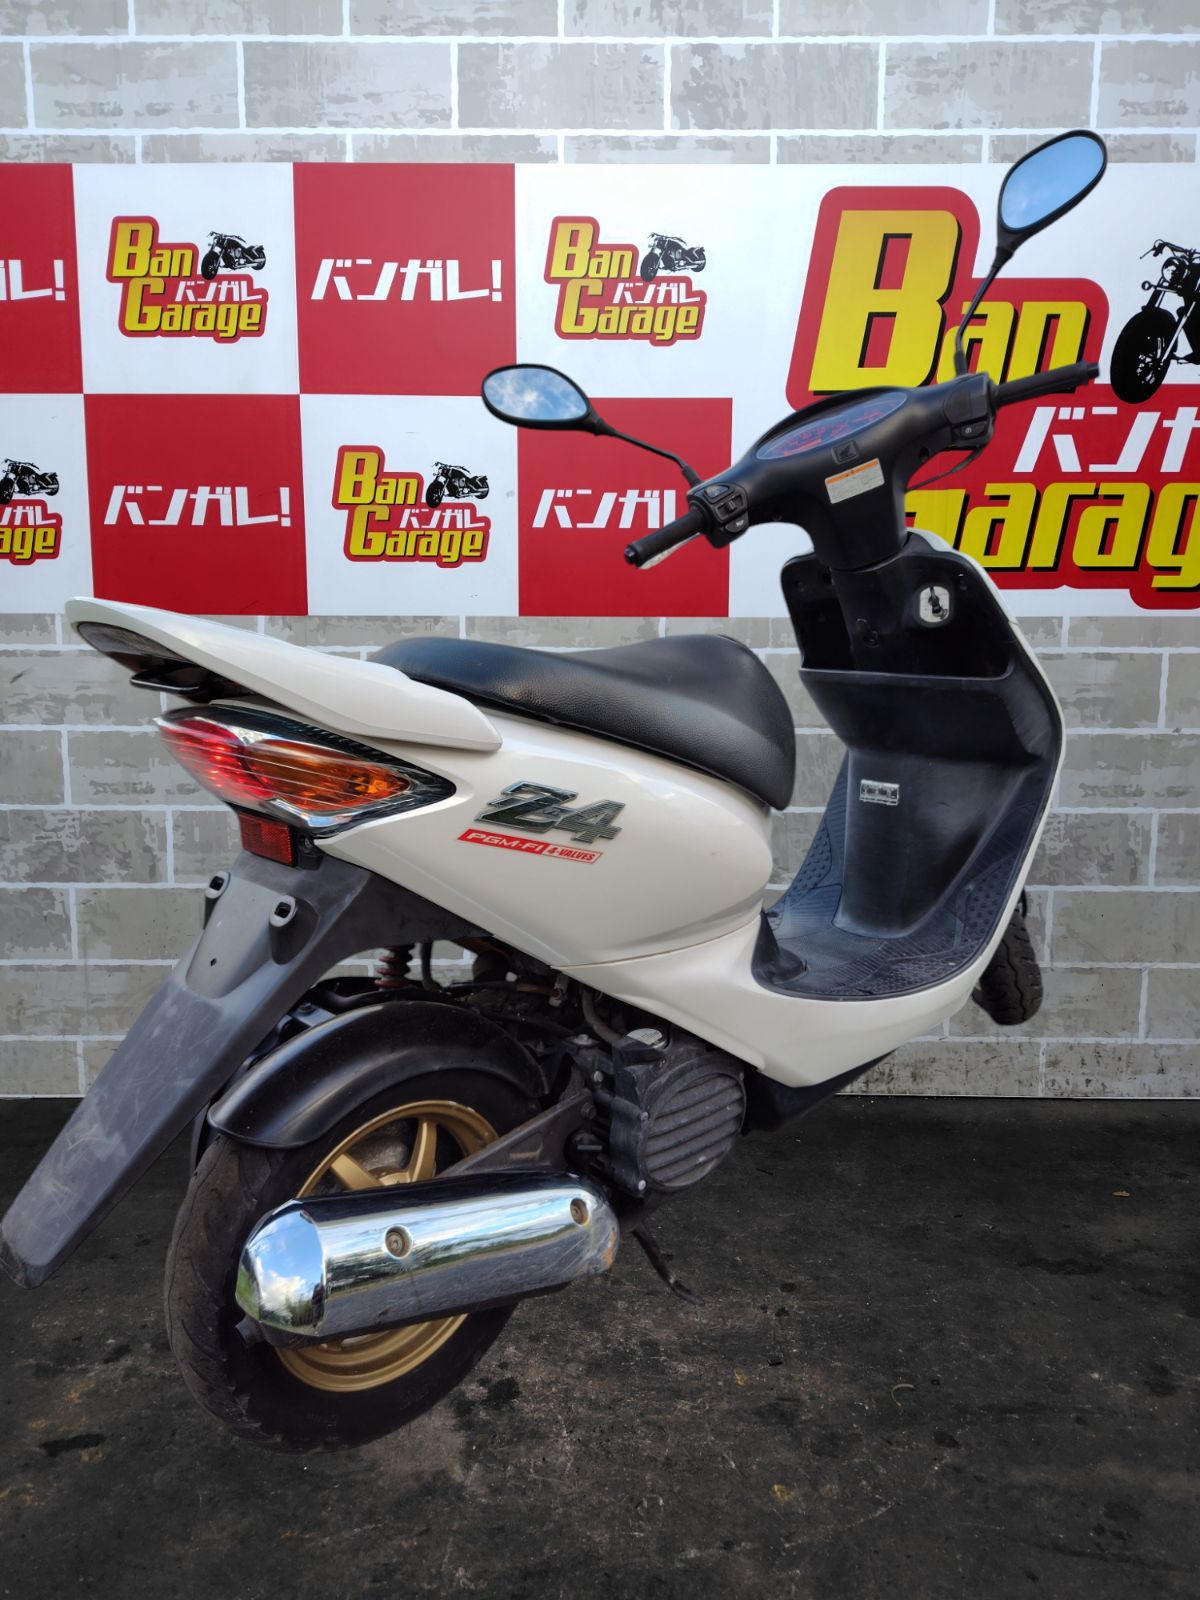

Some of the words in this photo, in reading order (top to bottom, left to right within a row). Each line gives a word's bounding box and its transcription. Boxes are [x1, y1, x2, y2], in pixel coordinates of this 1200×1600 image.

[112, 222, 193, 277] Ban
[550, 223, 633, 279] Ban
[0, 259, 65, 301] レ!
[175, 281, 262, 302] バンガレ
[310, 259, 502, 301] バンガレ!
[613, 282, 700, 304] バンガレ
[808, 210, 1091, 394] Ban
[125, 278, 262, 338] Garage
[561, 279, 699, 341] Garage
[338, 452, 419, 505] Ban
[103, 485, 291, 527] バンガレ!
[400, 508, 485, 529] バンガレ
[350, 505, 485, 563] Garage
